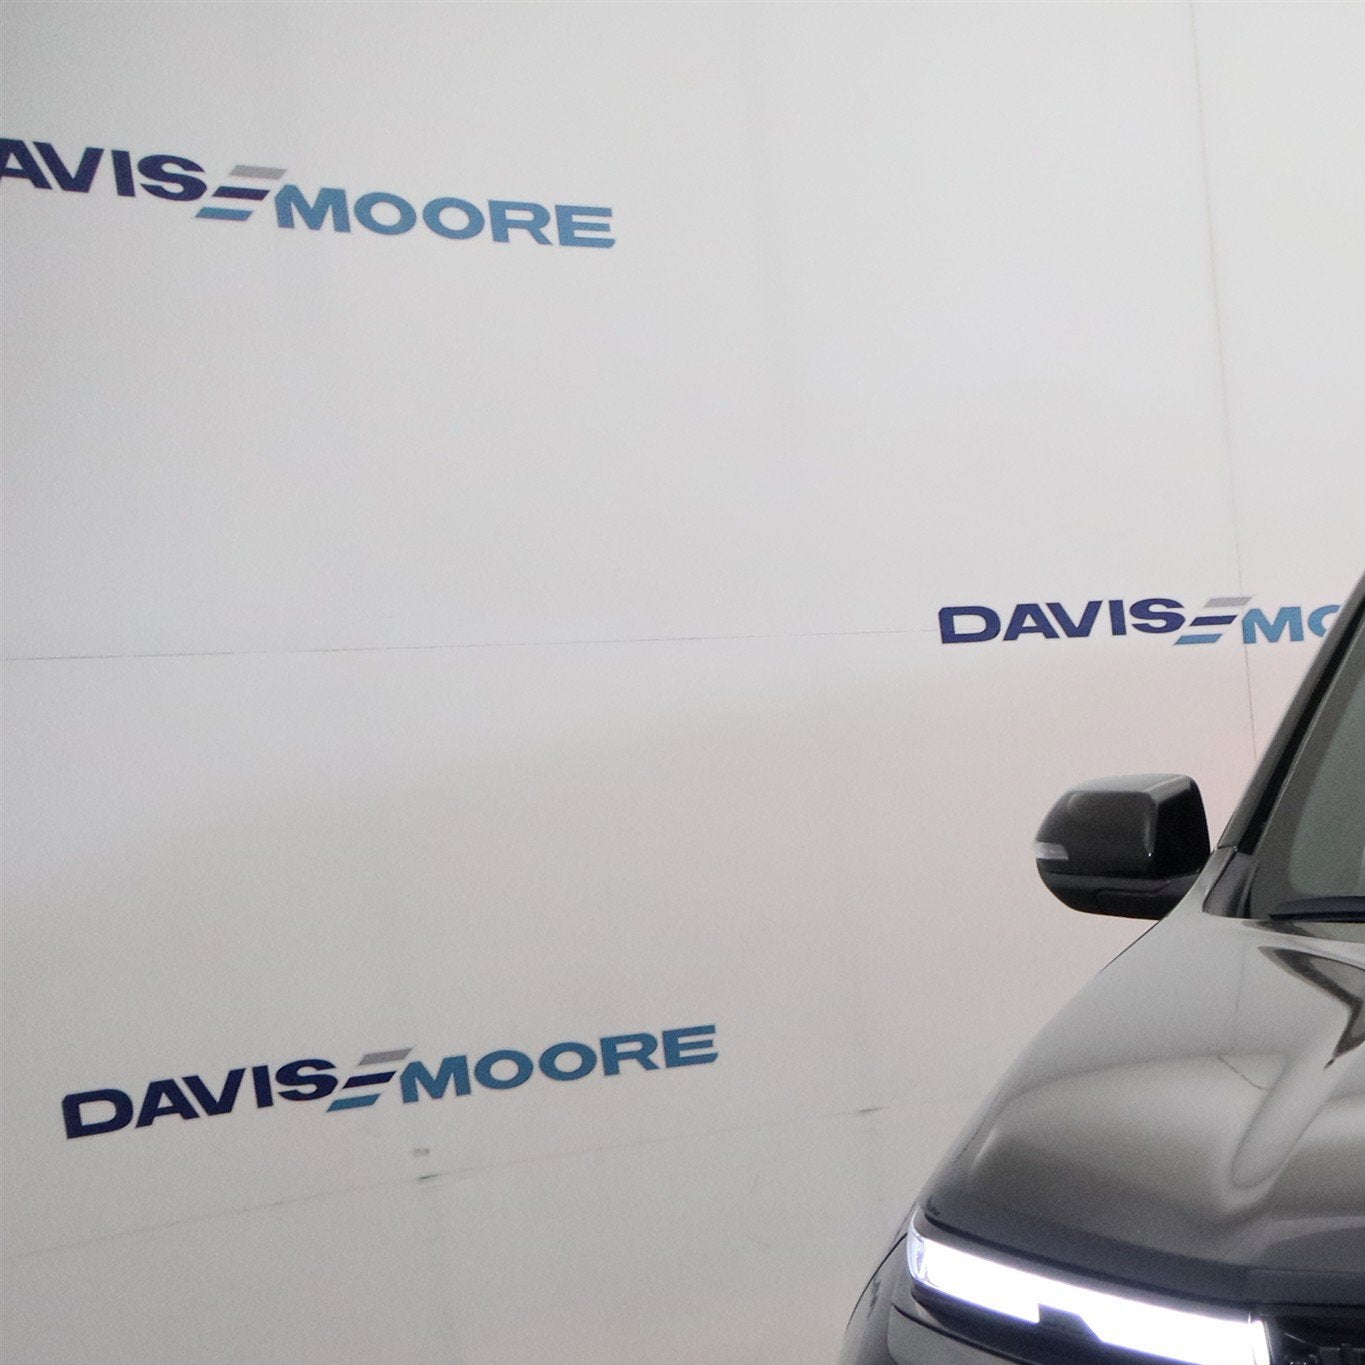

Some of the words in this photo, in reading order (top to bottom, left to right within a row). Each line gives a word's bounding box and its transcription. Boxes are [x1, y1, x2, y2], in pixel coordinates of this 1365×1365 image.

[0, 137, 208, 202] AVIS
[273, 183, 616, 249] MOORE
[937, 597, 1185, 645] DAVIS
[60, 1058, 339, 1140] DAVIS
[401, 1024, 719, 1105] MOORE
